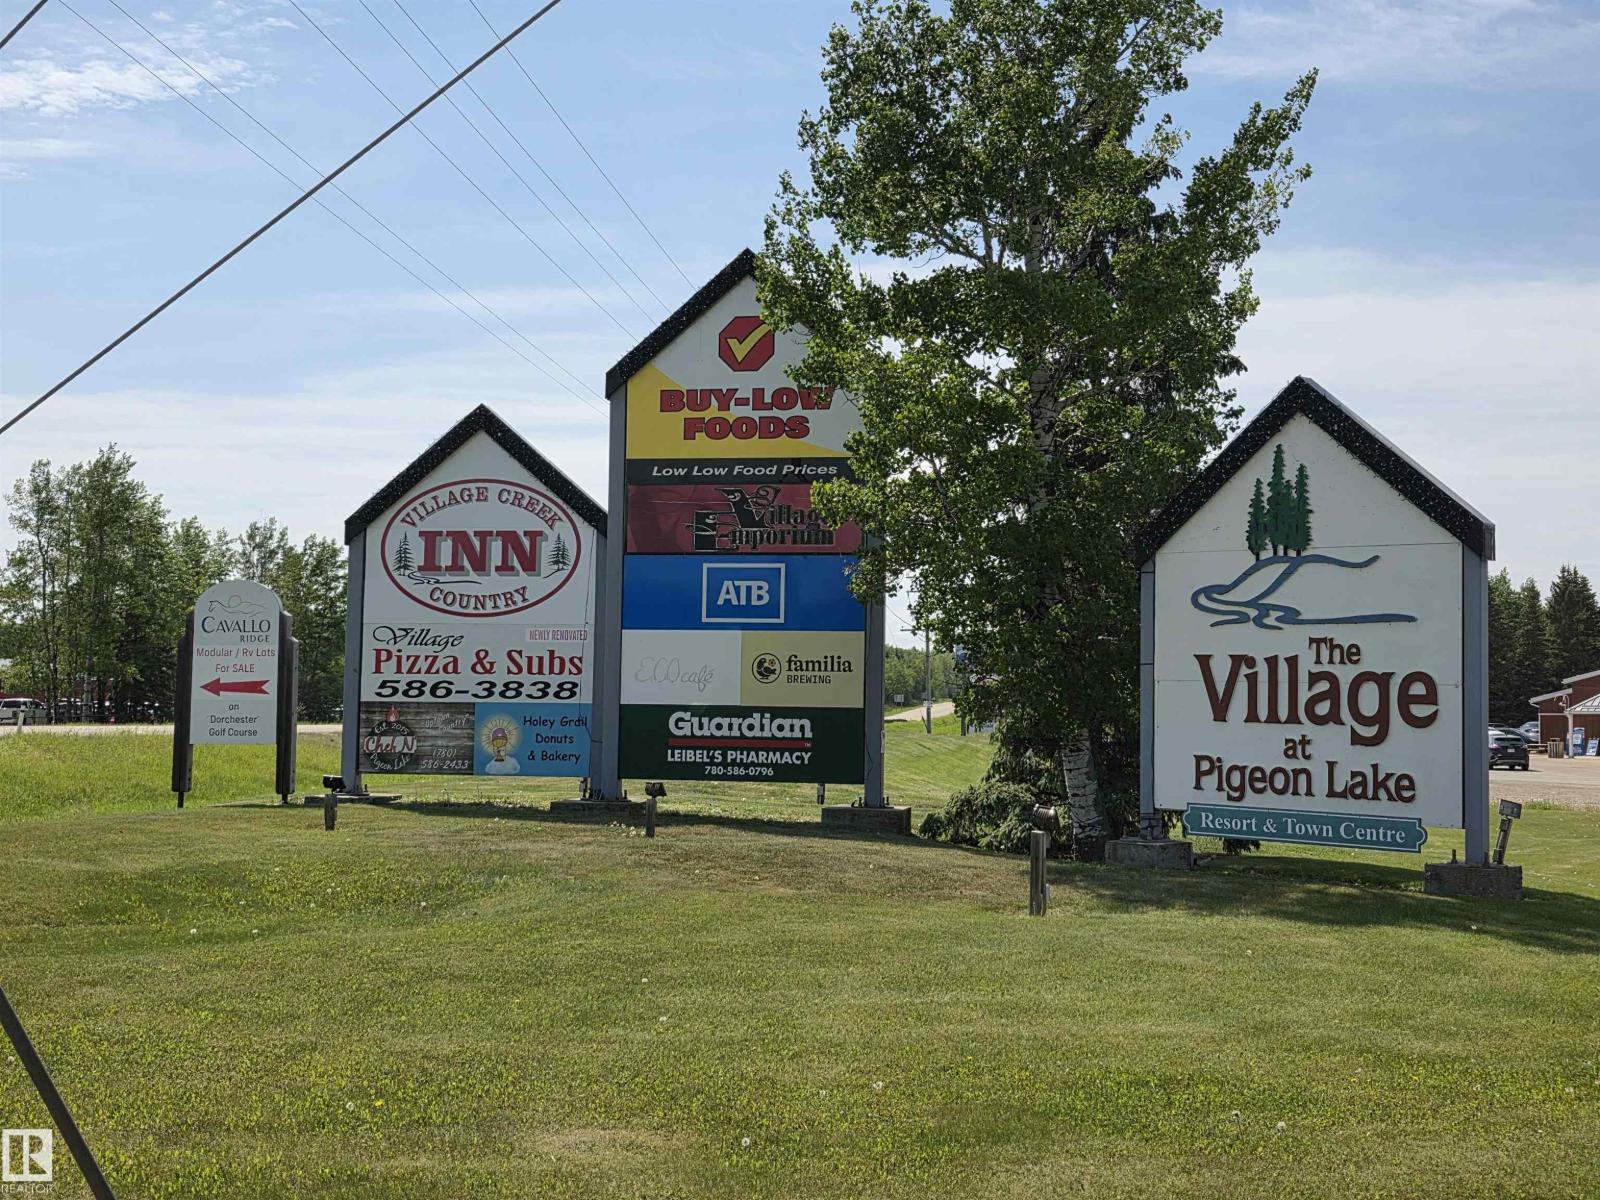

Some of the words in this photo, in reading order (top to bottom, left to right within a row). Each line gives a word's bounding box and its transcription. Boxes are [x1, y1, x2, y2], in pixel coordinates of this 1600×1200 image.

[659, 387, 835, 413] BUY-LOW
[683, 416, 810, 441] FOODS
[652, 465, 688, 477] Low
[692, 465, 728, 476] Low
[733, 464, 778, 475] Food
[782, 464, 838, 476] Prices
[400, 486, 489, 529] VILLAGE
[498, 488, 564, 531] CREEK
[417, 530, 549, 577] INN
[429, 586, 529, 611] COUNTRY
[717, 580, 770, 606] ATB
[201, 616, 271, 634] CAVALLO
[239, 635, 270, 643] RIDGE
[372, 625, 464, 653] Village
[529, 629, 550, 641] NEWLY
[551, 629, 588, 641] RENOVATED
[196, 648, 233, 657] Modular
[256, 648, 275, 657] Lots
[1309, 636, 1361, 665] The
[215, 663, 230, 673] For
[232, 663, 255, 673] SALE
[372, 648, 462, 675] Pizza
[470, 649, 496, 675] &
[506, 649, 583, 676] Subs
[786, 654, 853, 673] familia
[786, 674, 832, 684] BREWING
[374, 680, 579, 699] 586-3838
[1193, 654, 1439, 747] Village
[210, 715, 259, 724] Dorchester
[523, 715, 555, 729] Holey
[668, 711, 813, 738] Guardian
[208, 728, 226, 737] Golf
[227, 728, 258, 737] Course
[535, 733, 574, 744] Donuts
[432, 748, 456, 760] (780)
[1283, 734, 1312, 760] at
[420, 760, 469, 769] 586-2433
[527, 750, 536, 761] &
[541, 750, 580, 765] Bakery
[667, 749, 722, 763] LEIBEL'S
[727, 750, 812, 765] PHARMACY
[704, 766, 774, 776] 780-586-0796
[1193, 754, 1315, 802] Pigeon
[1325, 760, 1416, 804] Lake
[1200, 812, 1257, 832] Resort
[1263, 819, 1277, 833] &
[1283, 817, 1333, 838] Town
[1339, 822, 1406, 843] Centre
